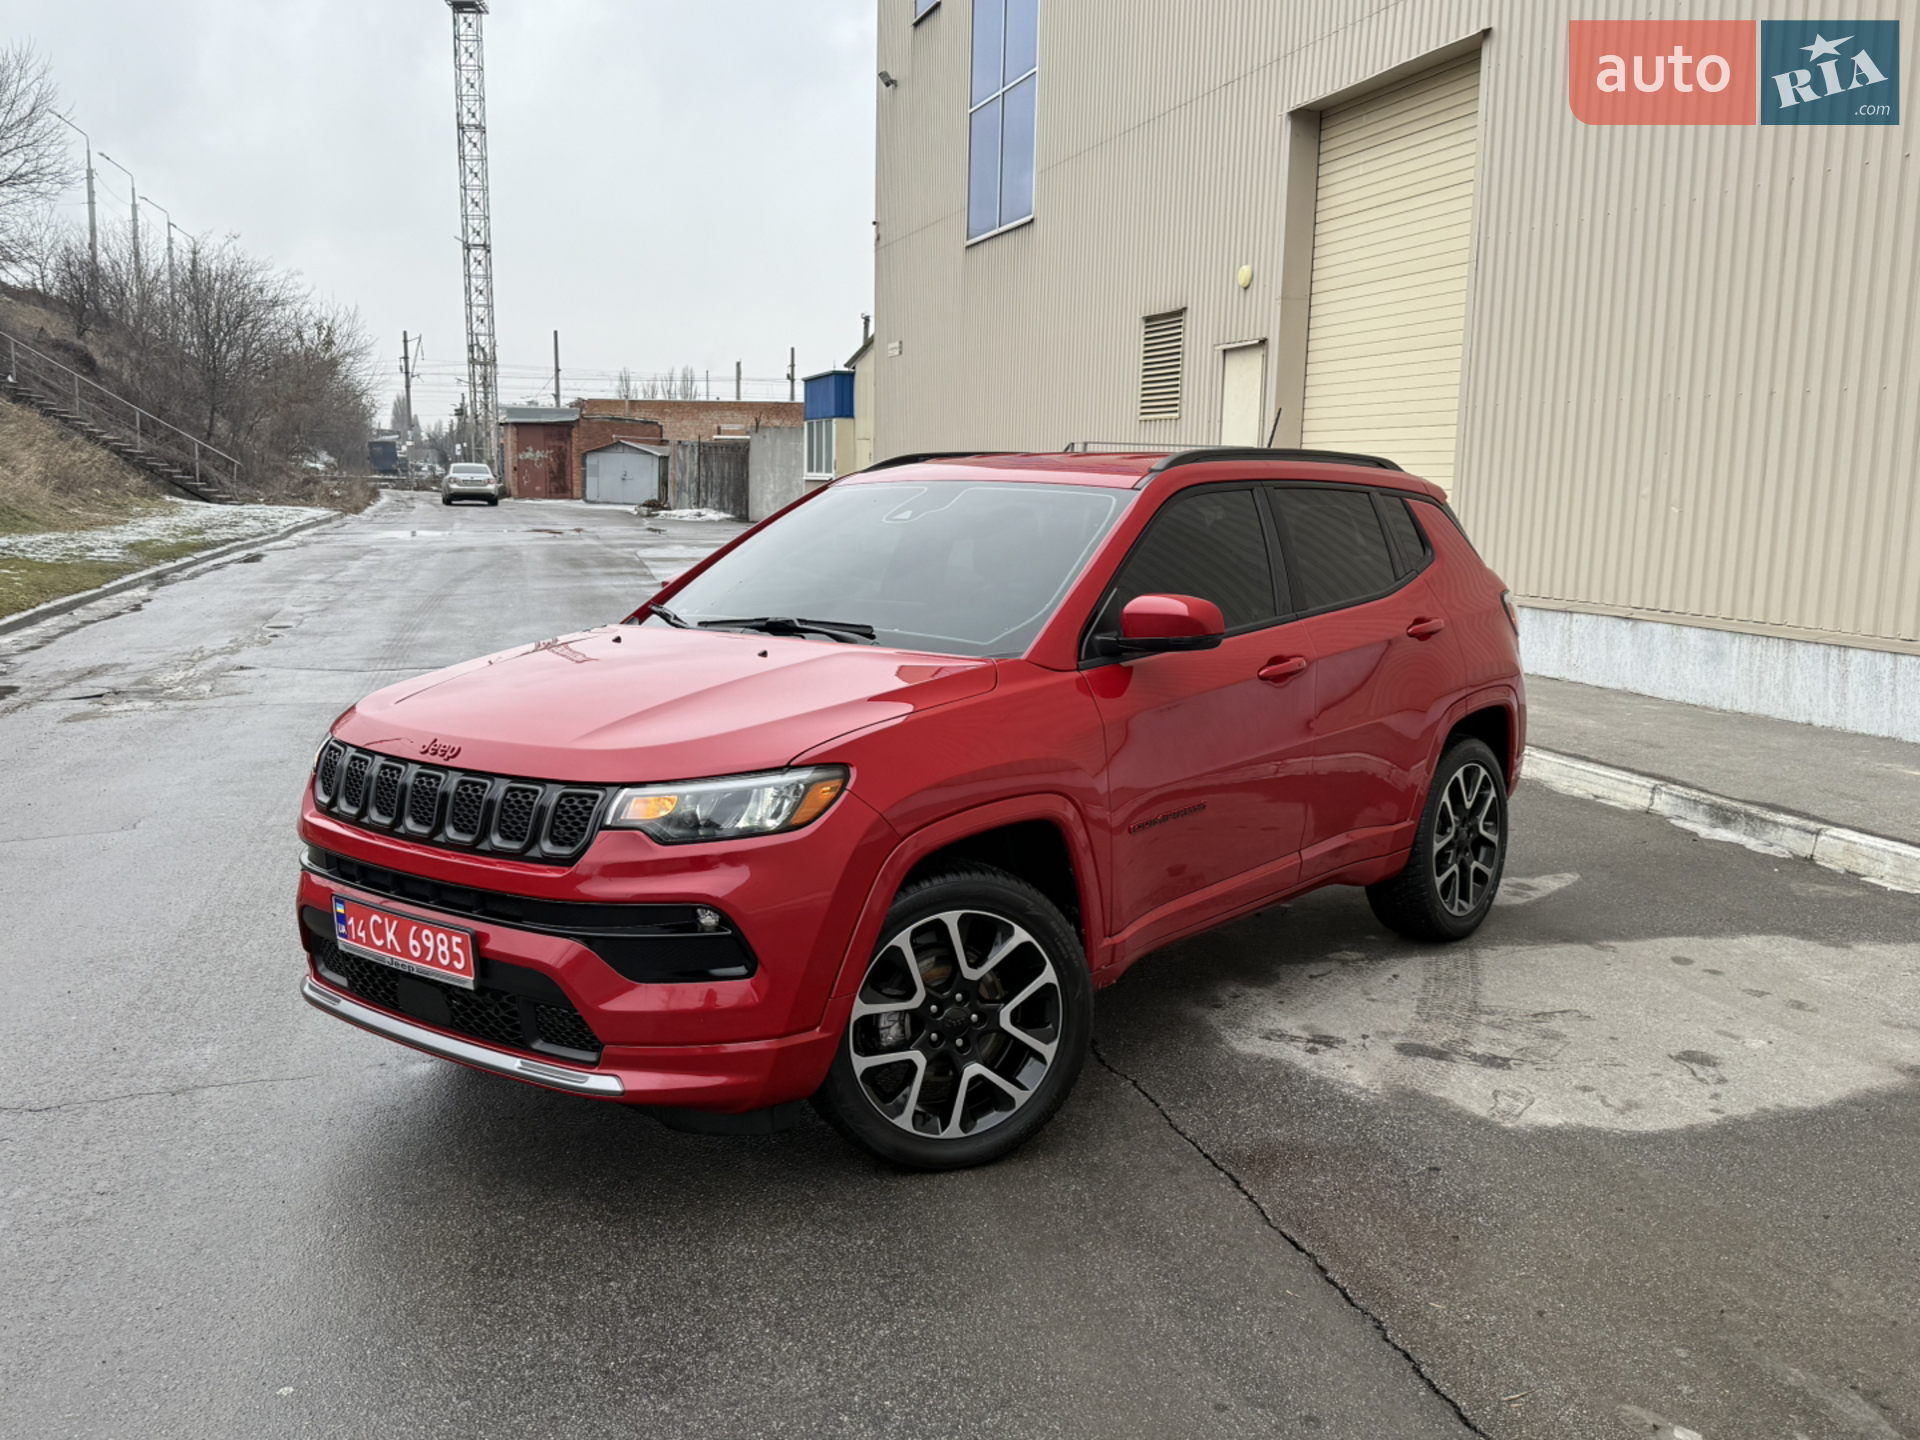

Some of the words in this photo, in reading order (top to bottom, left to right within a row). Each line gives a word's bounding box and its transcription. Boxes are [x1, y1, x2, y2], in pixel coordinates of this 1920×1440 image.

[420, 738, 462, 761] Jeep
[348, 917, 366, 943] 14
[370, 914, 402, 952] CK
[409, 926, 465, 970] 6985
